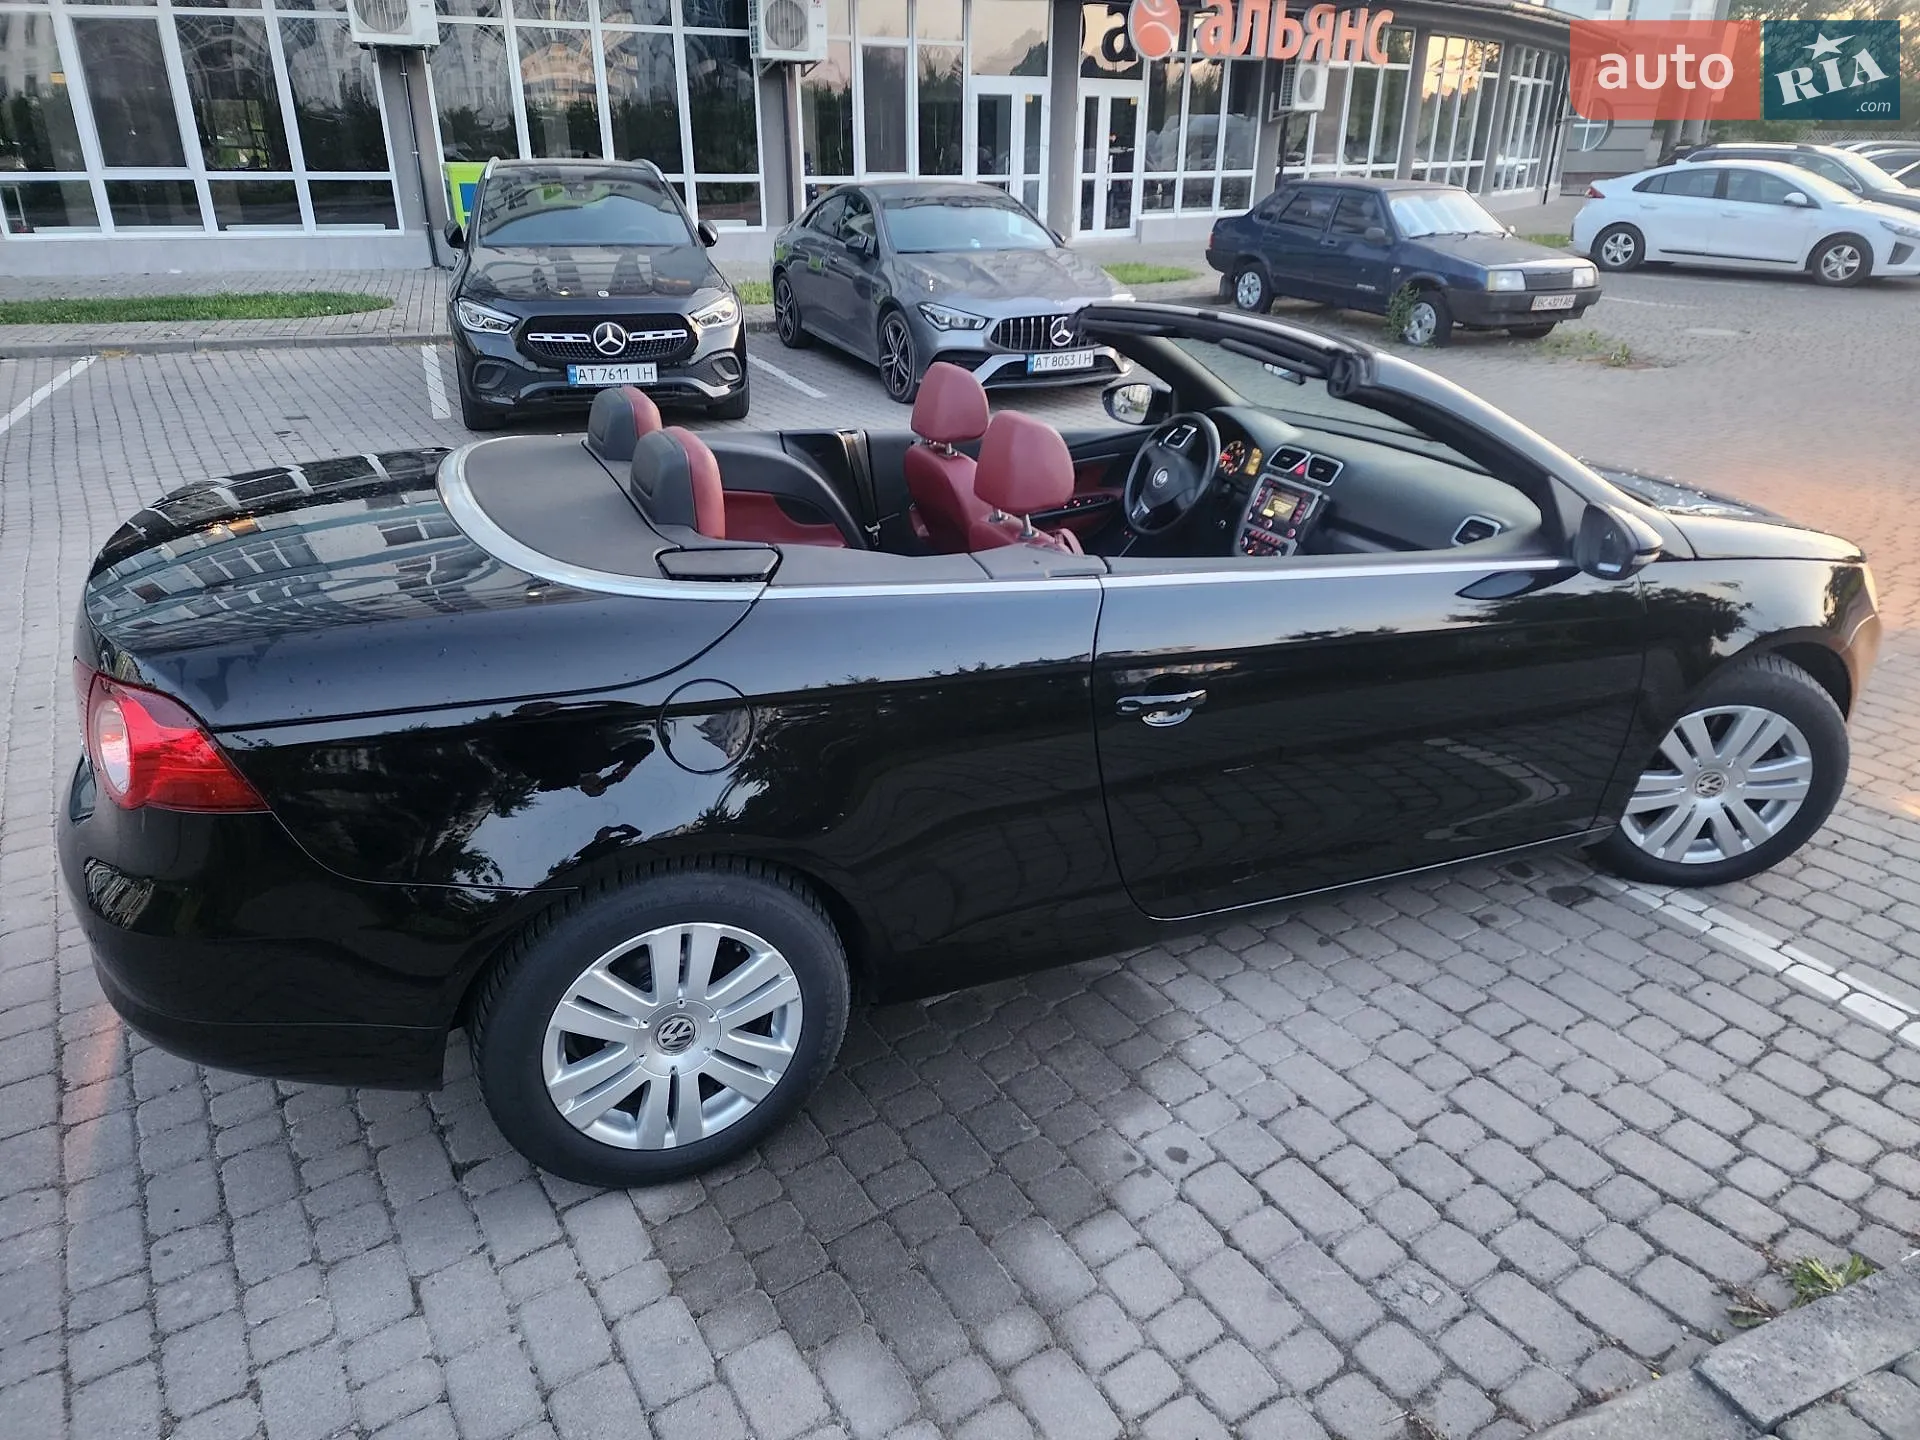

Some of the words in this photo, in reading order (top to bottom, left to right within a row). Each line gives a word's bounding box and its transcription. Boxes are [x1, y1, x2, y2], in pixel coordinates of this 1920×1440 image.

[1035, 356, 1049, 369] AT
[578, 368, 596, 382] AT
[600, 368, 630, 381] 7611
[637, 367, 654, 380] IH
